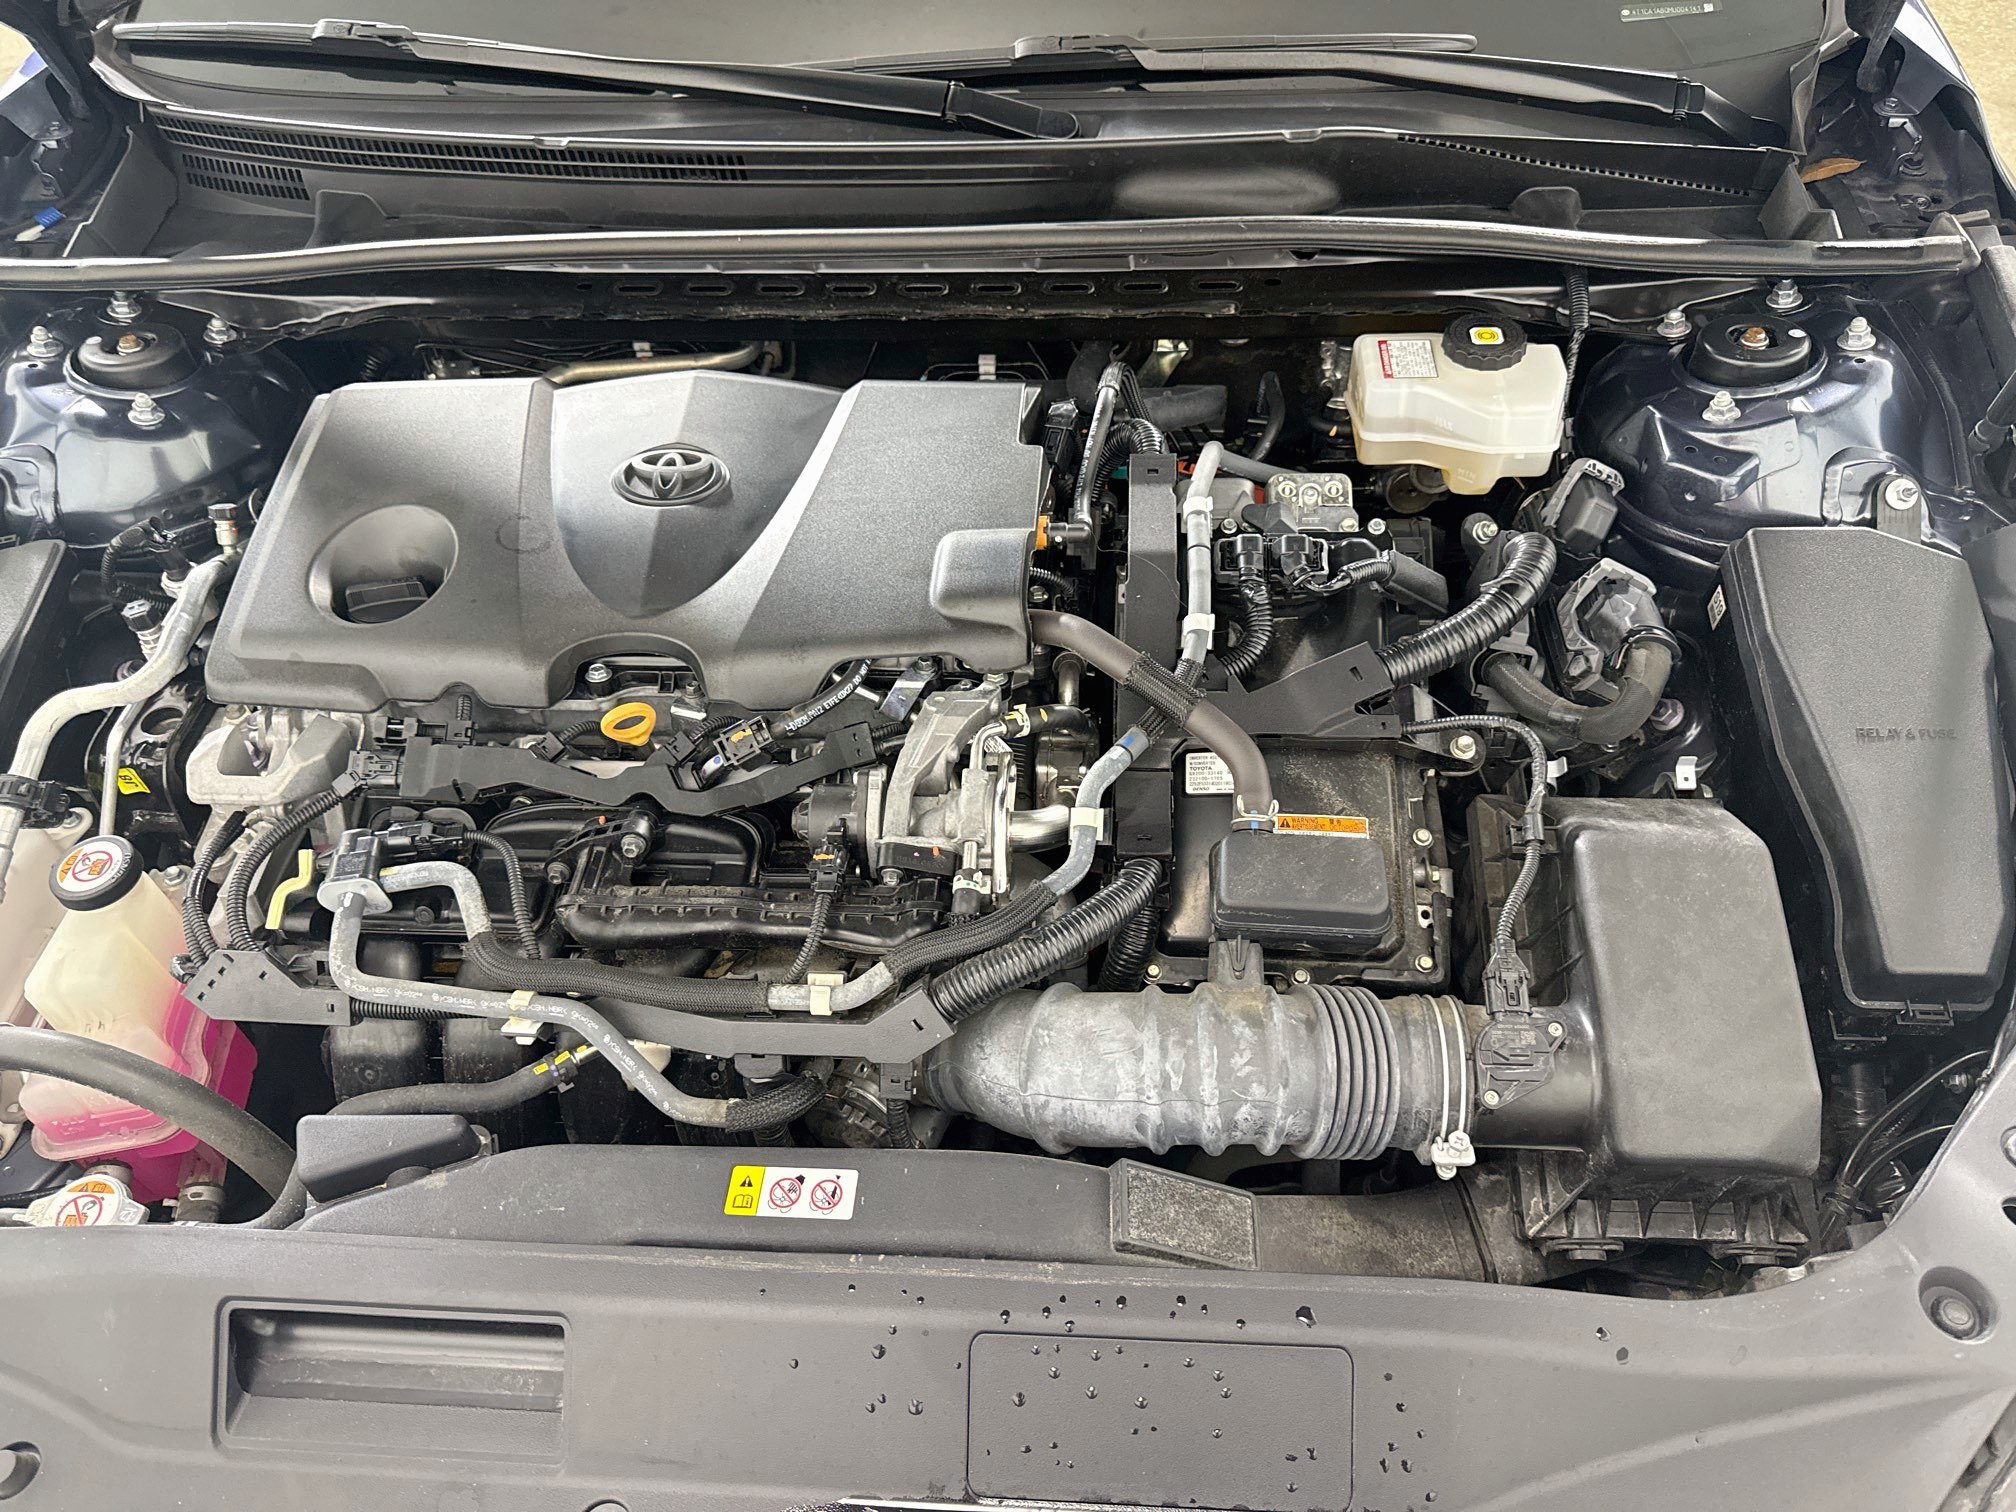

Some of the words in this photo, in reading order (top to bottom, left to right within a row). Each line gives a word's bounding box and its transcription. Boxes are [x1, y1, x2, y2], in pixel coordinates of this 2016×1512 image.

[852, 674, 862, 686] DO
[1855, 727, 1903, 741] RELAY
[1904, 728, 1916, 741] &
[1918, 728, 1958, 741] FUSE
